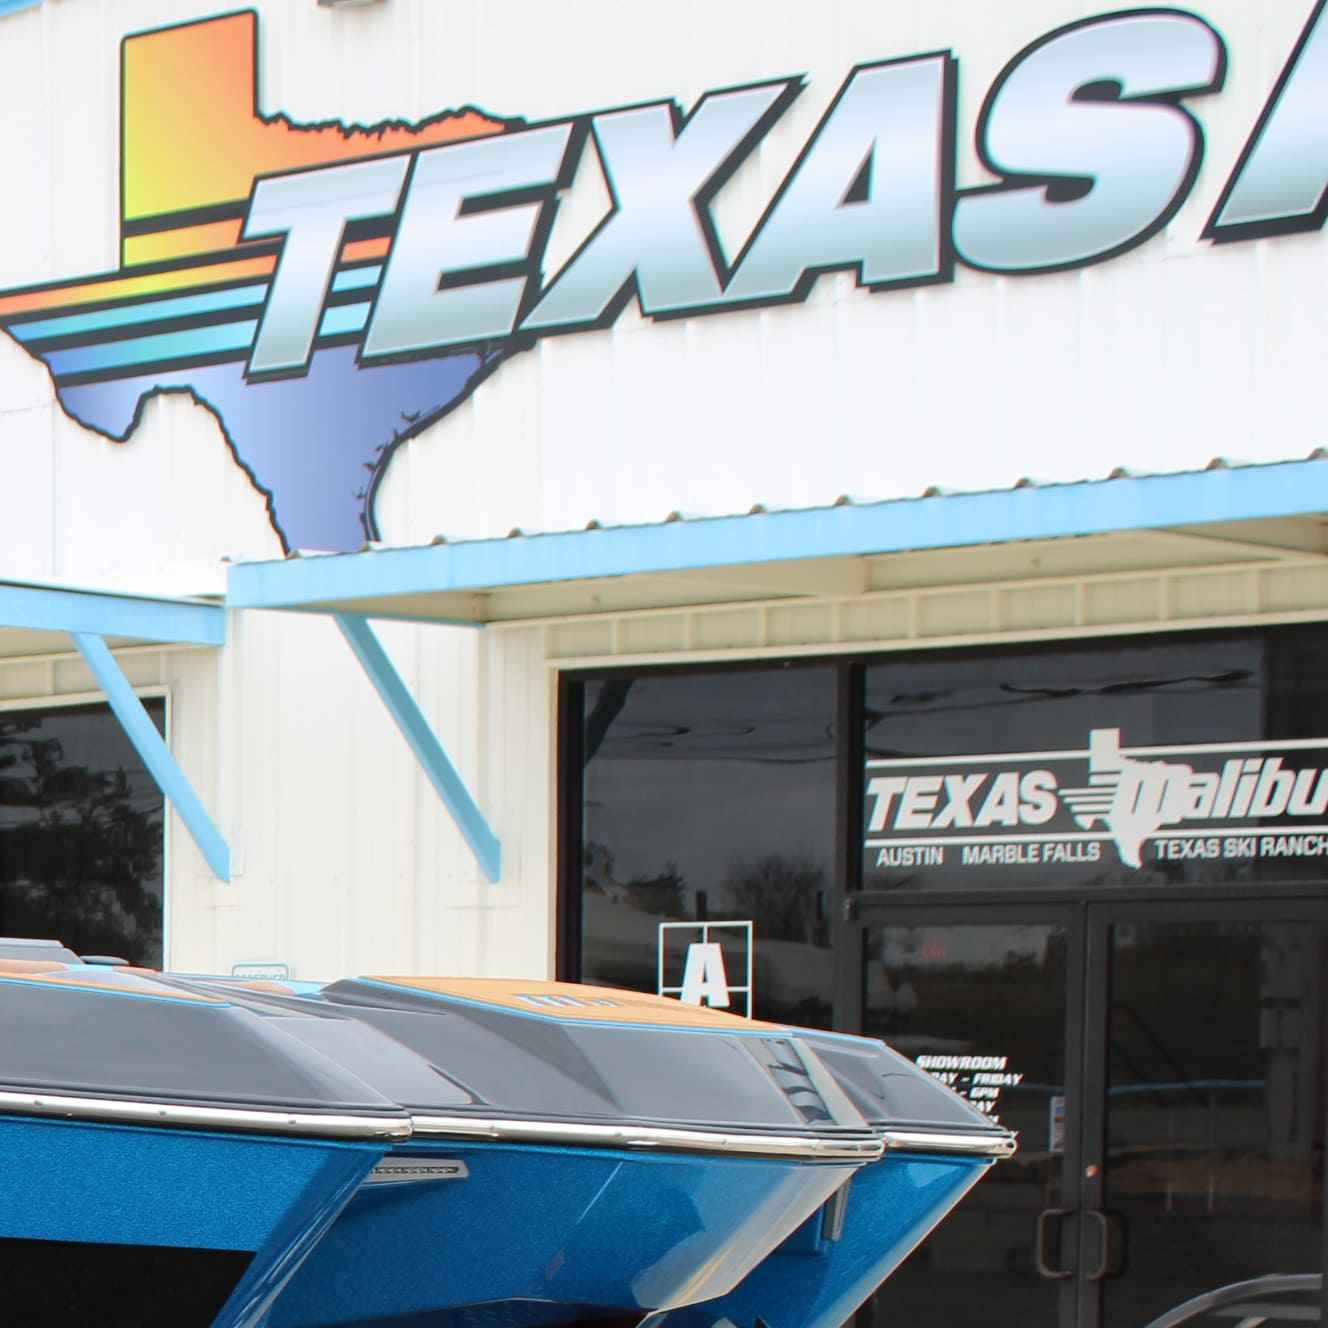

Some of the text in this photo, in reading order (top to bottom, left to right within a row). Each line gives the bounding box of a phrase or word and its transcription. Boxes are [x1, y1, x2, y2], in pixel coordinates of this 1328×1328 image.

[236, 6, 1230, 384] TEXAS
[866, 757, 1328, 832] TEXAS Malibu
[876, 834, 1328, 867] AUSTIN MARBLE FALLS TEXAS SKI RANCH
[680, 942, 730, 1007] A
[916, 1055, 1008, 1071] SHOWROOM
[972, 1073, 1024, 1086] FRIDAY
